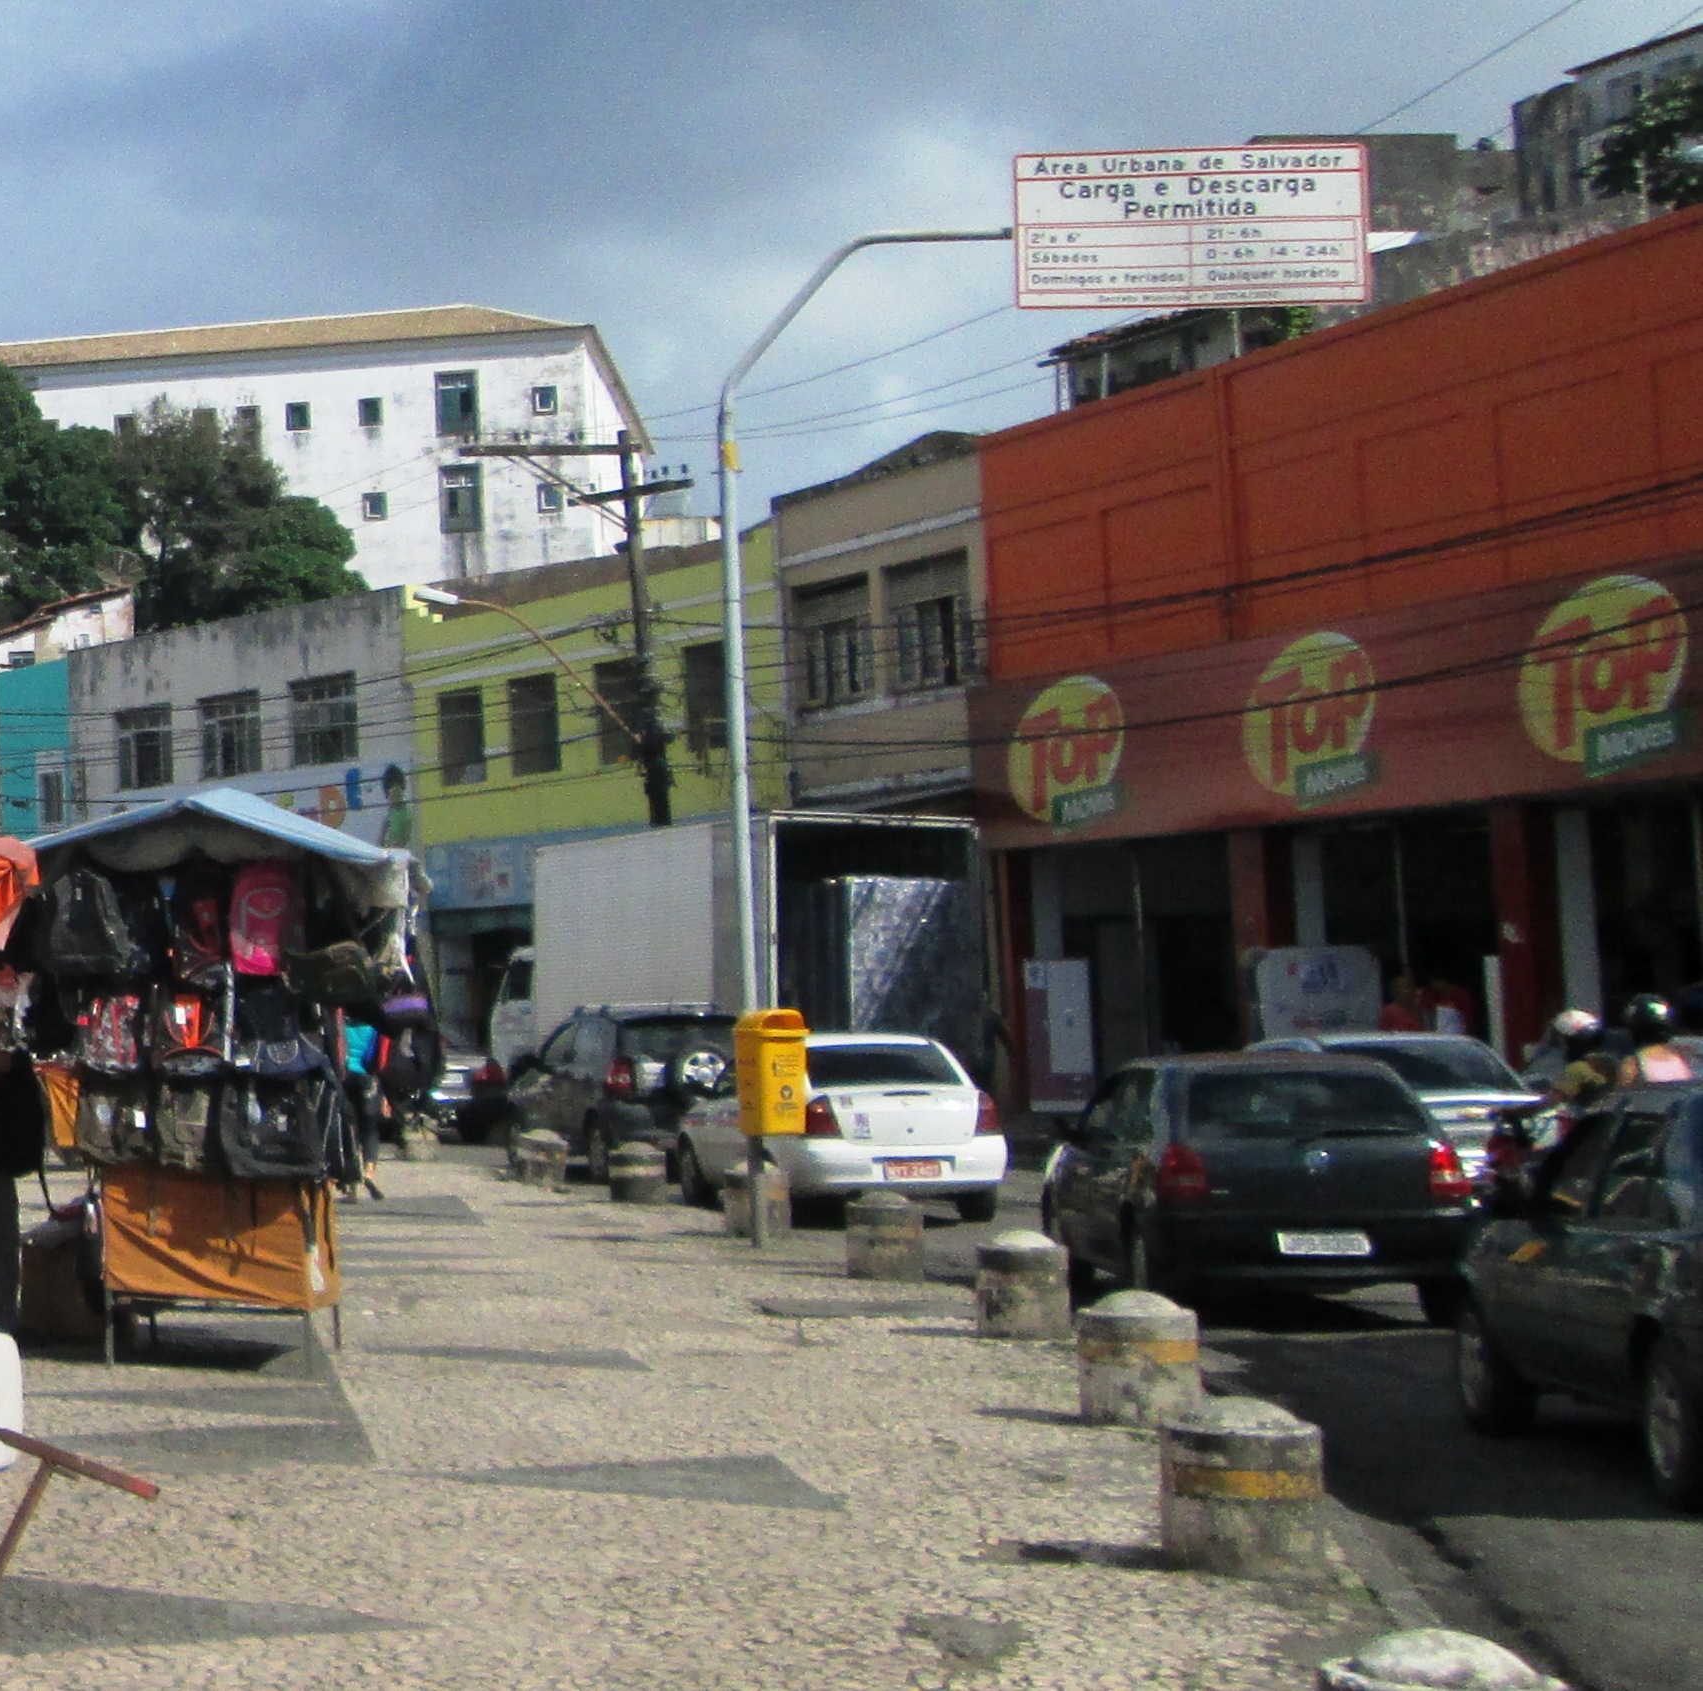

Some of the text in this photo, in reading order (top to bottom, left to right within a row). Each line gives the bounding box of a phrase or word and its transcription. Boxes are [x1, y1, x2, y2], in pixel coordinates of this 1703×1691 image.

[1034, 153, 1343, 176] Área Urbana de Salvador
[1059, 176, 1316, 203] Carga e Descarga
[1123, 198, 1257, 219] Permitida
[1031, 271, 1185, 287] Domingos e feriados
[1207, 269, 1277, 282] Qualquer
